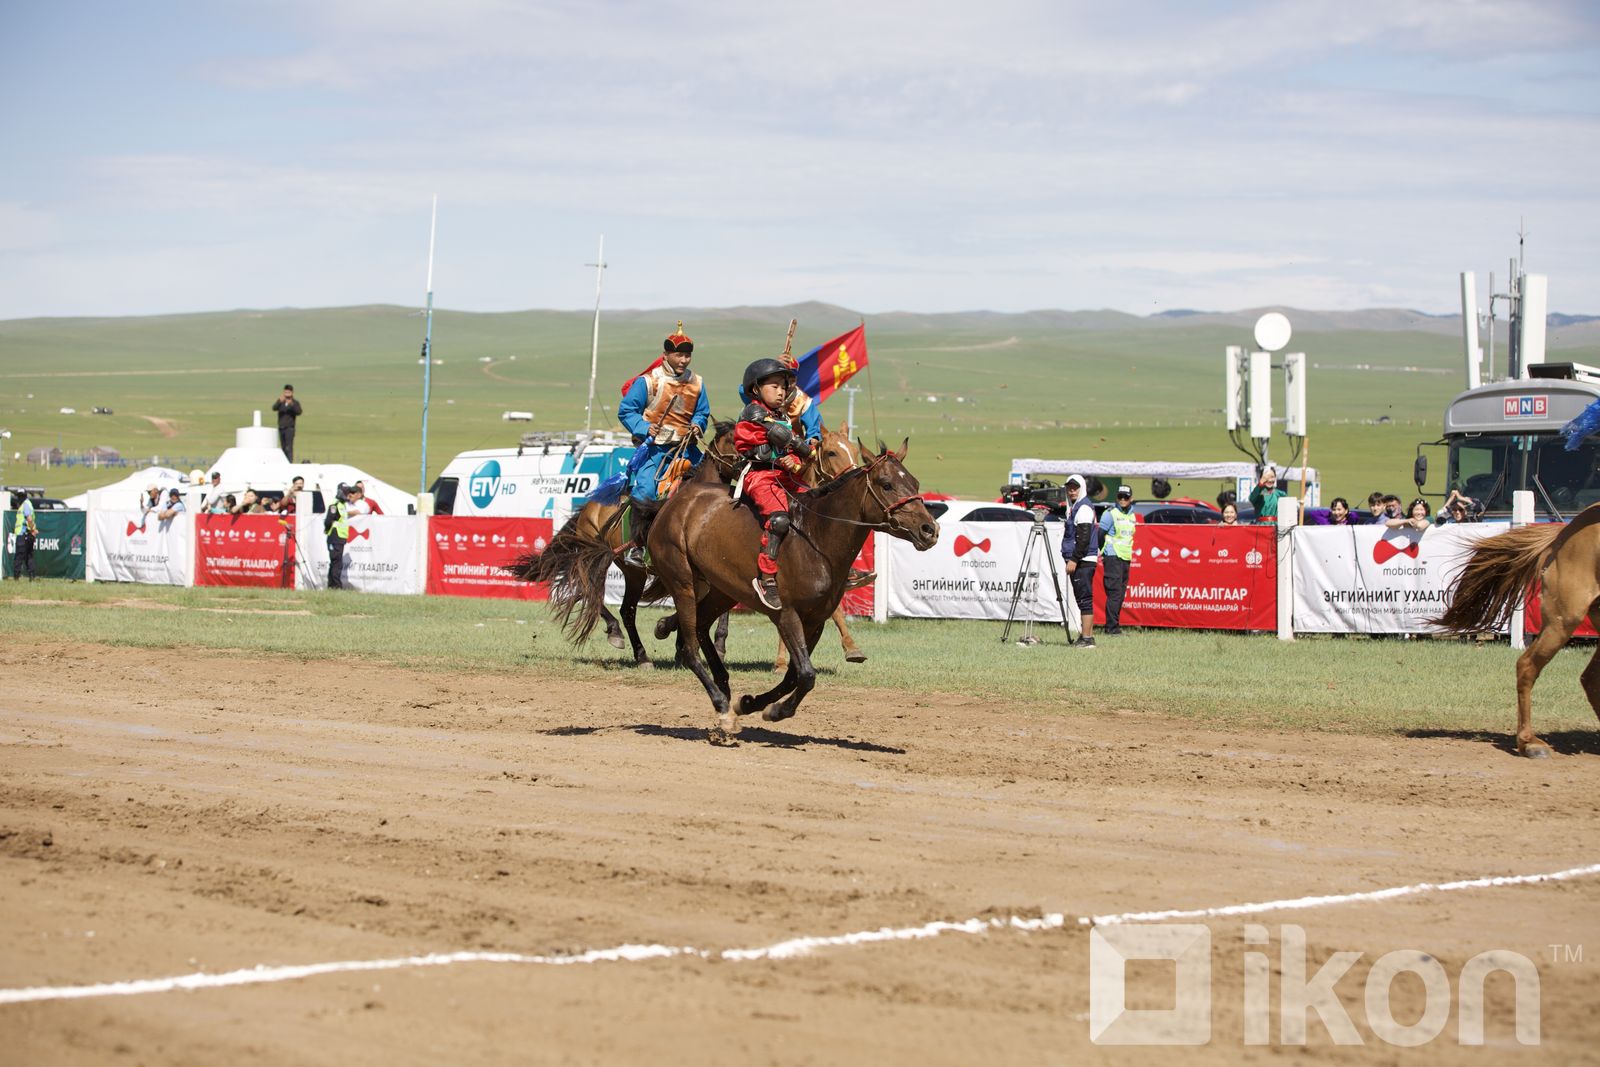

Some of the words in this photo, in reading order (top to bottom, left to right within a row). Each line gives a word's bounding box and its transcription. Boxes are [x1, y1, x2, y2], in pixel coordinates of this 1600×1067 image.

[1506, 401, 1545, 413] MNB
[471, 476, 501, 497] ETV
[501, 483, 517, 495] HD
[564, 478, 591, 494] HD
[40, 538, 60, 551] БАНК
[961, 559, 997, 569] mobicom
[1383, 565, 1427, 576] mobicom
[912, 577, 976, 592] ЭНГИЙНИЙГ
[1180, 586, 1248, 601] УХААЛГААР
[1323, 587, 1400, 602] ЭНГИЙНИЙГ
